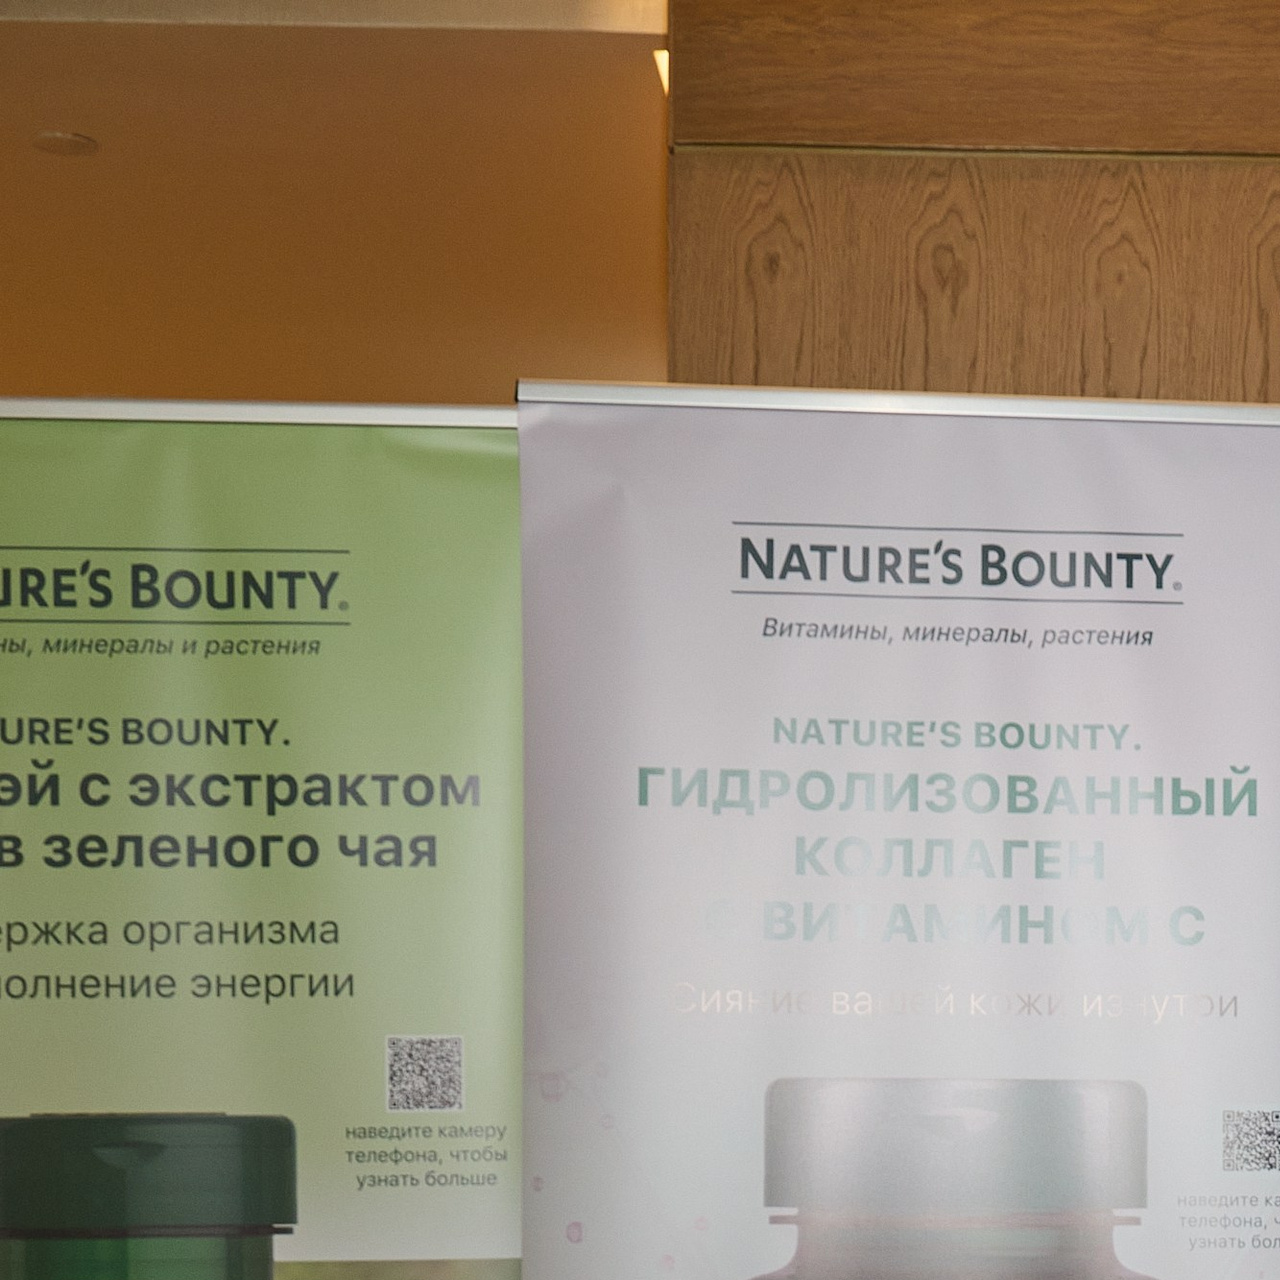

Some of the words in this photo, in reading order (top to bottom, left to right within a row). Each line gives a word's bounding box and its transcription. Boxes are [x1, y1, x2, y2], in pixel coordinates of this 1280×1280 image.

[739, 537, 963, 588] NATURE'S
[0, 559, 112, 608] RE'S
[42, 637, 173, 658] минералы
[181, 639, 198, 655] и
[203, 638, 321, 659] растения
[762, 617, 894, 646] Витамины,
[902, 622, 1034, 649] минералы,
[1042, 625, 1154, 649] растения
[0, 718, 110, 746] URE'S
[772, 717, 962, 749] NATURE'S
[0, 758, 60, 806] эй
[79, 772, 111, 806] с
[128, 769, 482, 815] экстрактом
[637, 766, 1259, 818] ГИДРОЛИЗОВАННЫЙ
[43, 833, 320, 869] зеленого
[338, 834, 439, 869] чая
[795, 836, 1106, 880] КОЛЛАГЕН
[0, 919, 107, 951] ржка
[123, 919, 340, 952] организма
[762, 900, 1149, 944] ВИАМИНМ
[0, 971, 176, 998] олнение
[191, 973, 355, 1004] энергии
[831, 983, 956, 1016] вай
[969, 992, 1062, 1017] кжи
[345, 1125, 434, 1142] наведите
[438, 1124, 508, 1143] камеру
[345, 1145, 443, 1165] телефона,
[449, 1145, 508, 1162] чтобы
[356, 1171, 420, 1190] узнать
[424, 1169, 498, 1187] больше
[1177, 1194, 1259, 1208] наведите
[1180, 1214, 1267, 1231] телефона,
[1189, 1236, 1246, 1252] узнать
